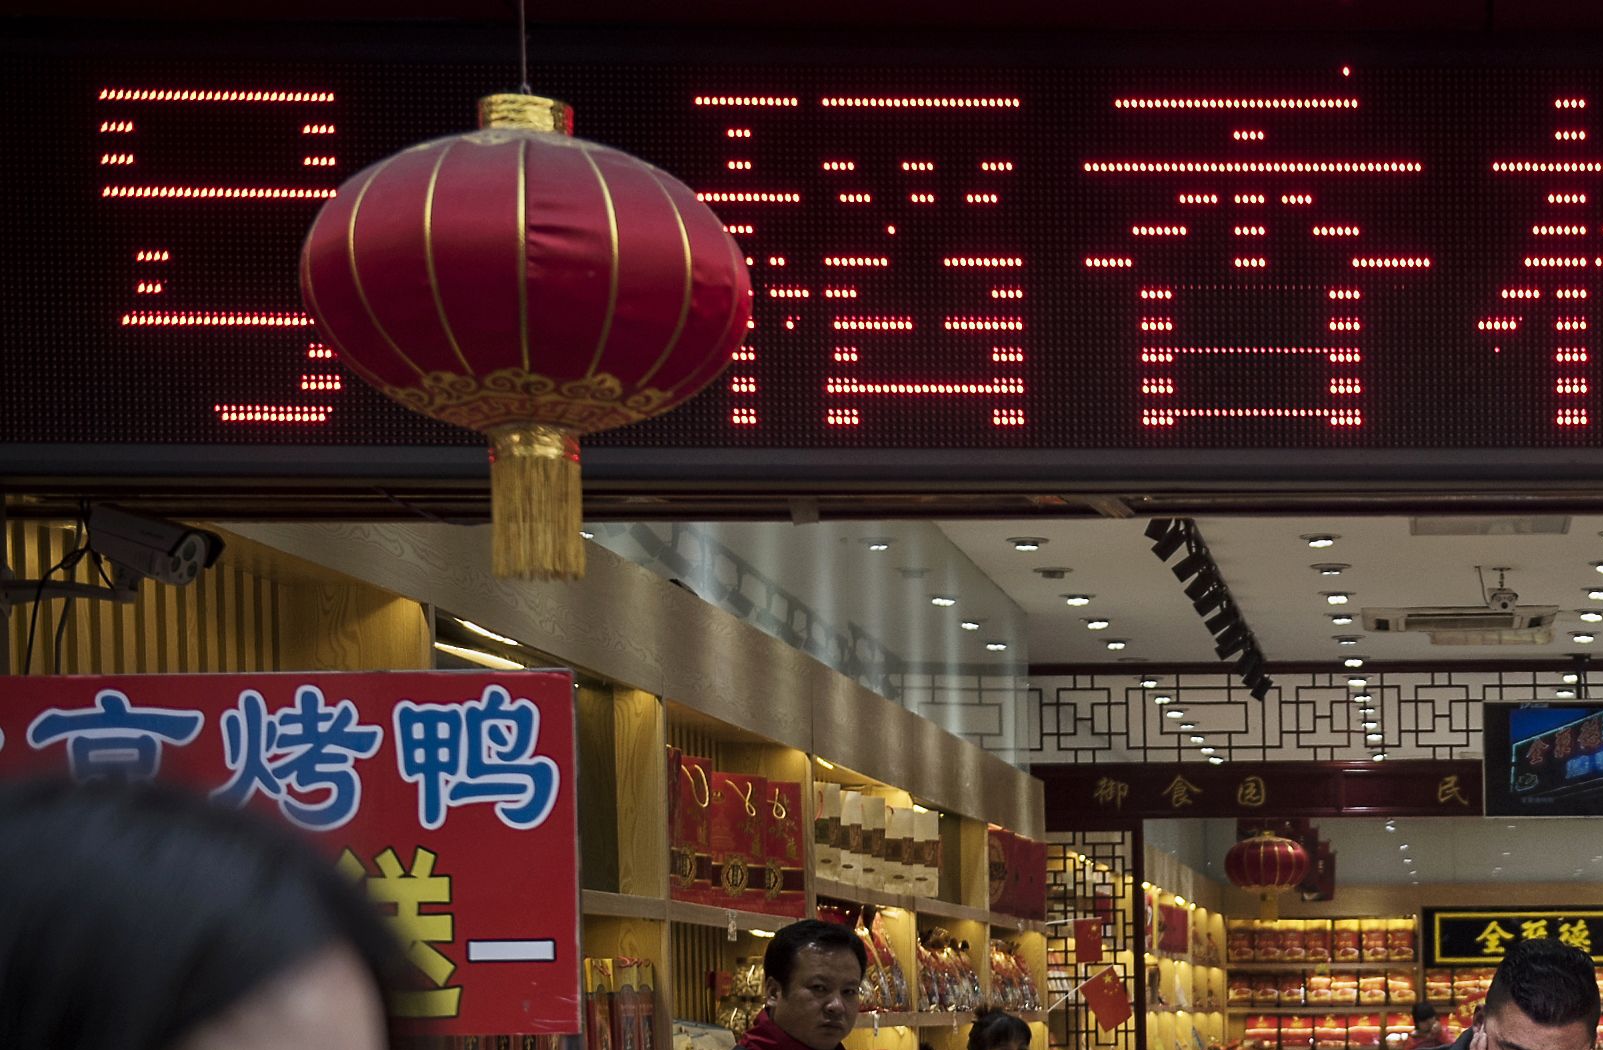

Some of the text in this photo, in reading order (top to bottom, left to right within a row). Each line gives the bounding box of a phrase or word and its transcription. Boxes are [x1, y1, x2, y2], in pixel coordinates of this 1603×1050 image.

[0, 683, 562, 832] 京烤鸭
[1094, 774, 1267, 813] 御食园
